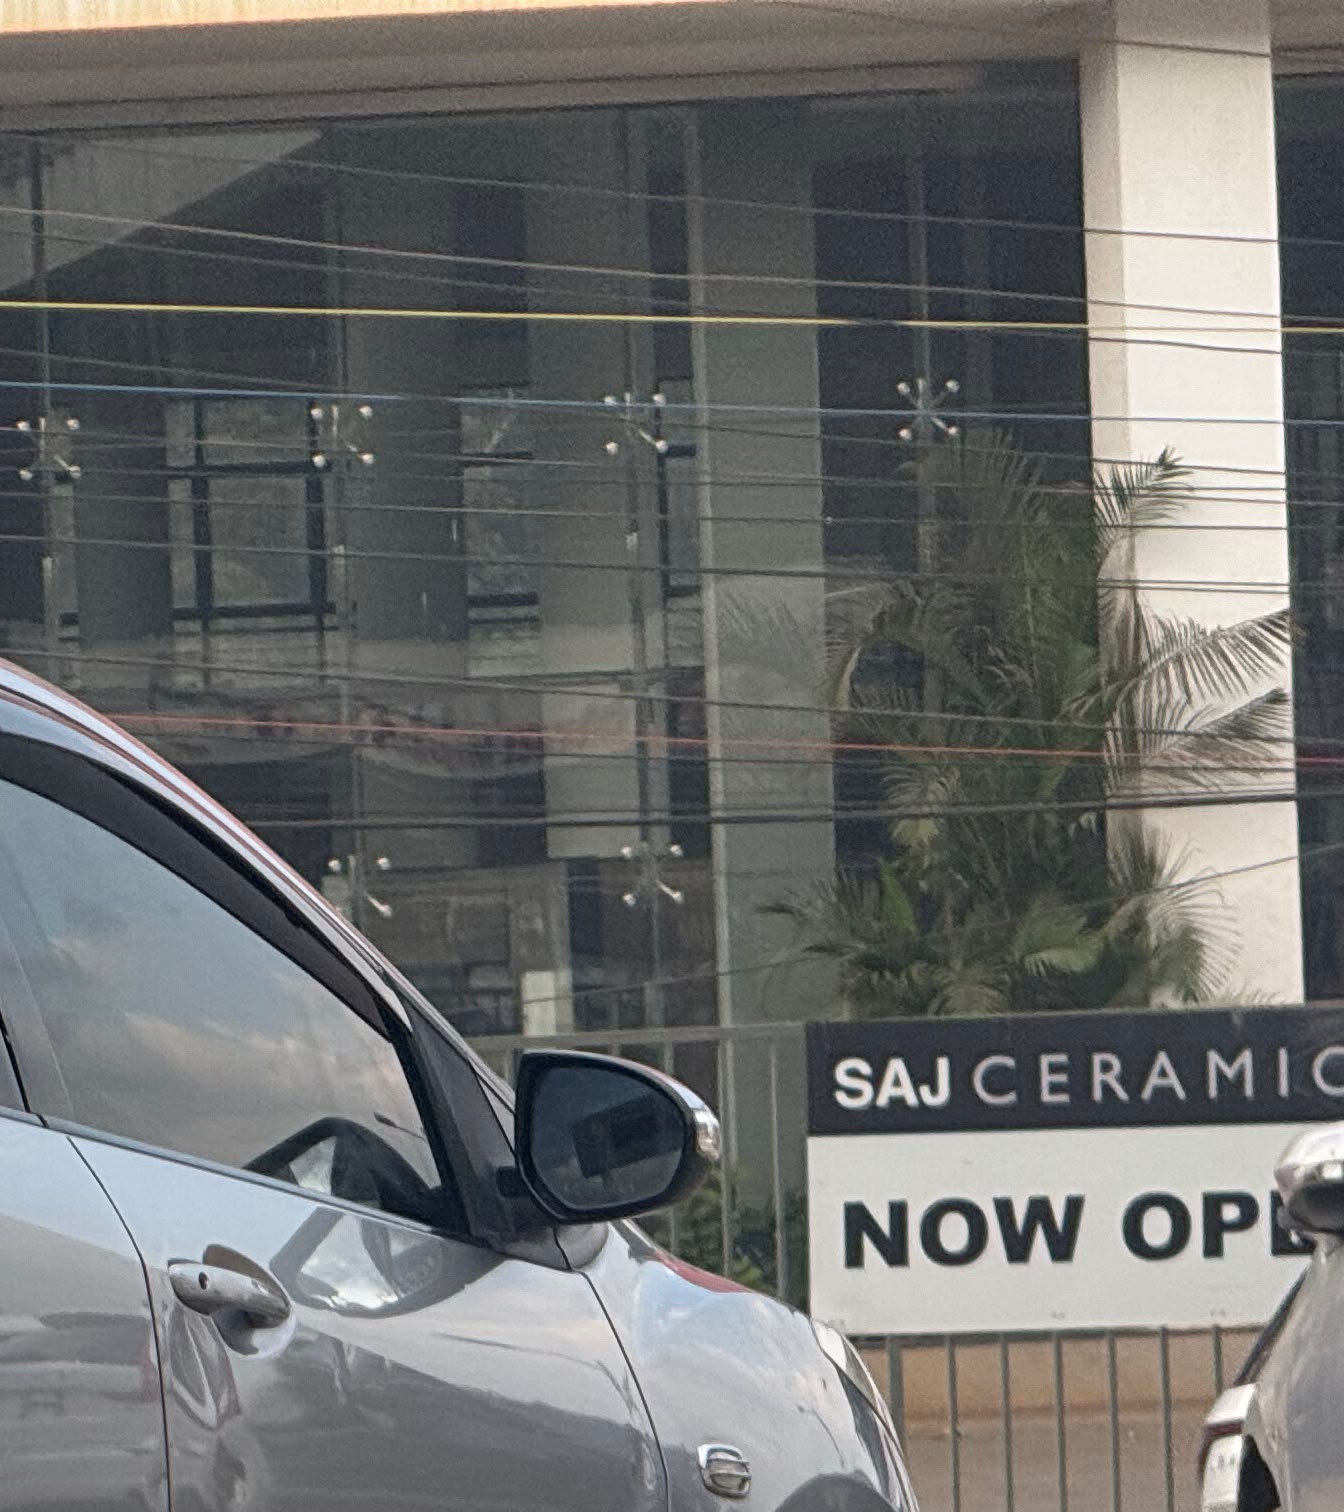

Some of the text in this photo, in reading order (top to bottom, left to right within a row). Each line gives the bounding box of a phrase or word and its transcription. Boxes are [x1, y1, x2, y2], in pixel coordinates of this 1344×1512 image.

[834, 1045, 1344, 1111] SAJ CERAMIC
[843, 1194, 1085, 1270] NOW
